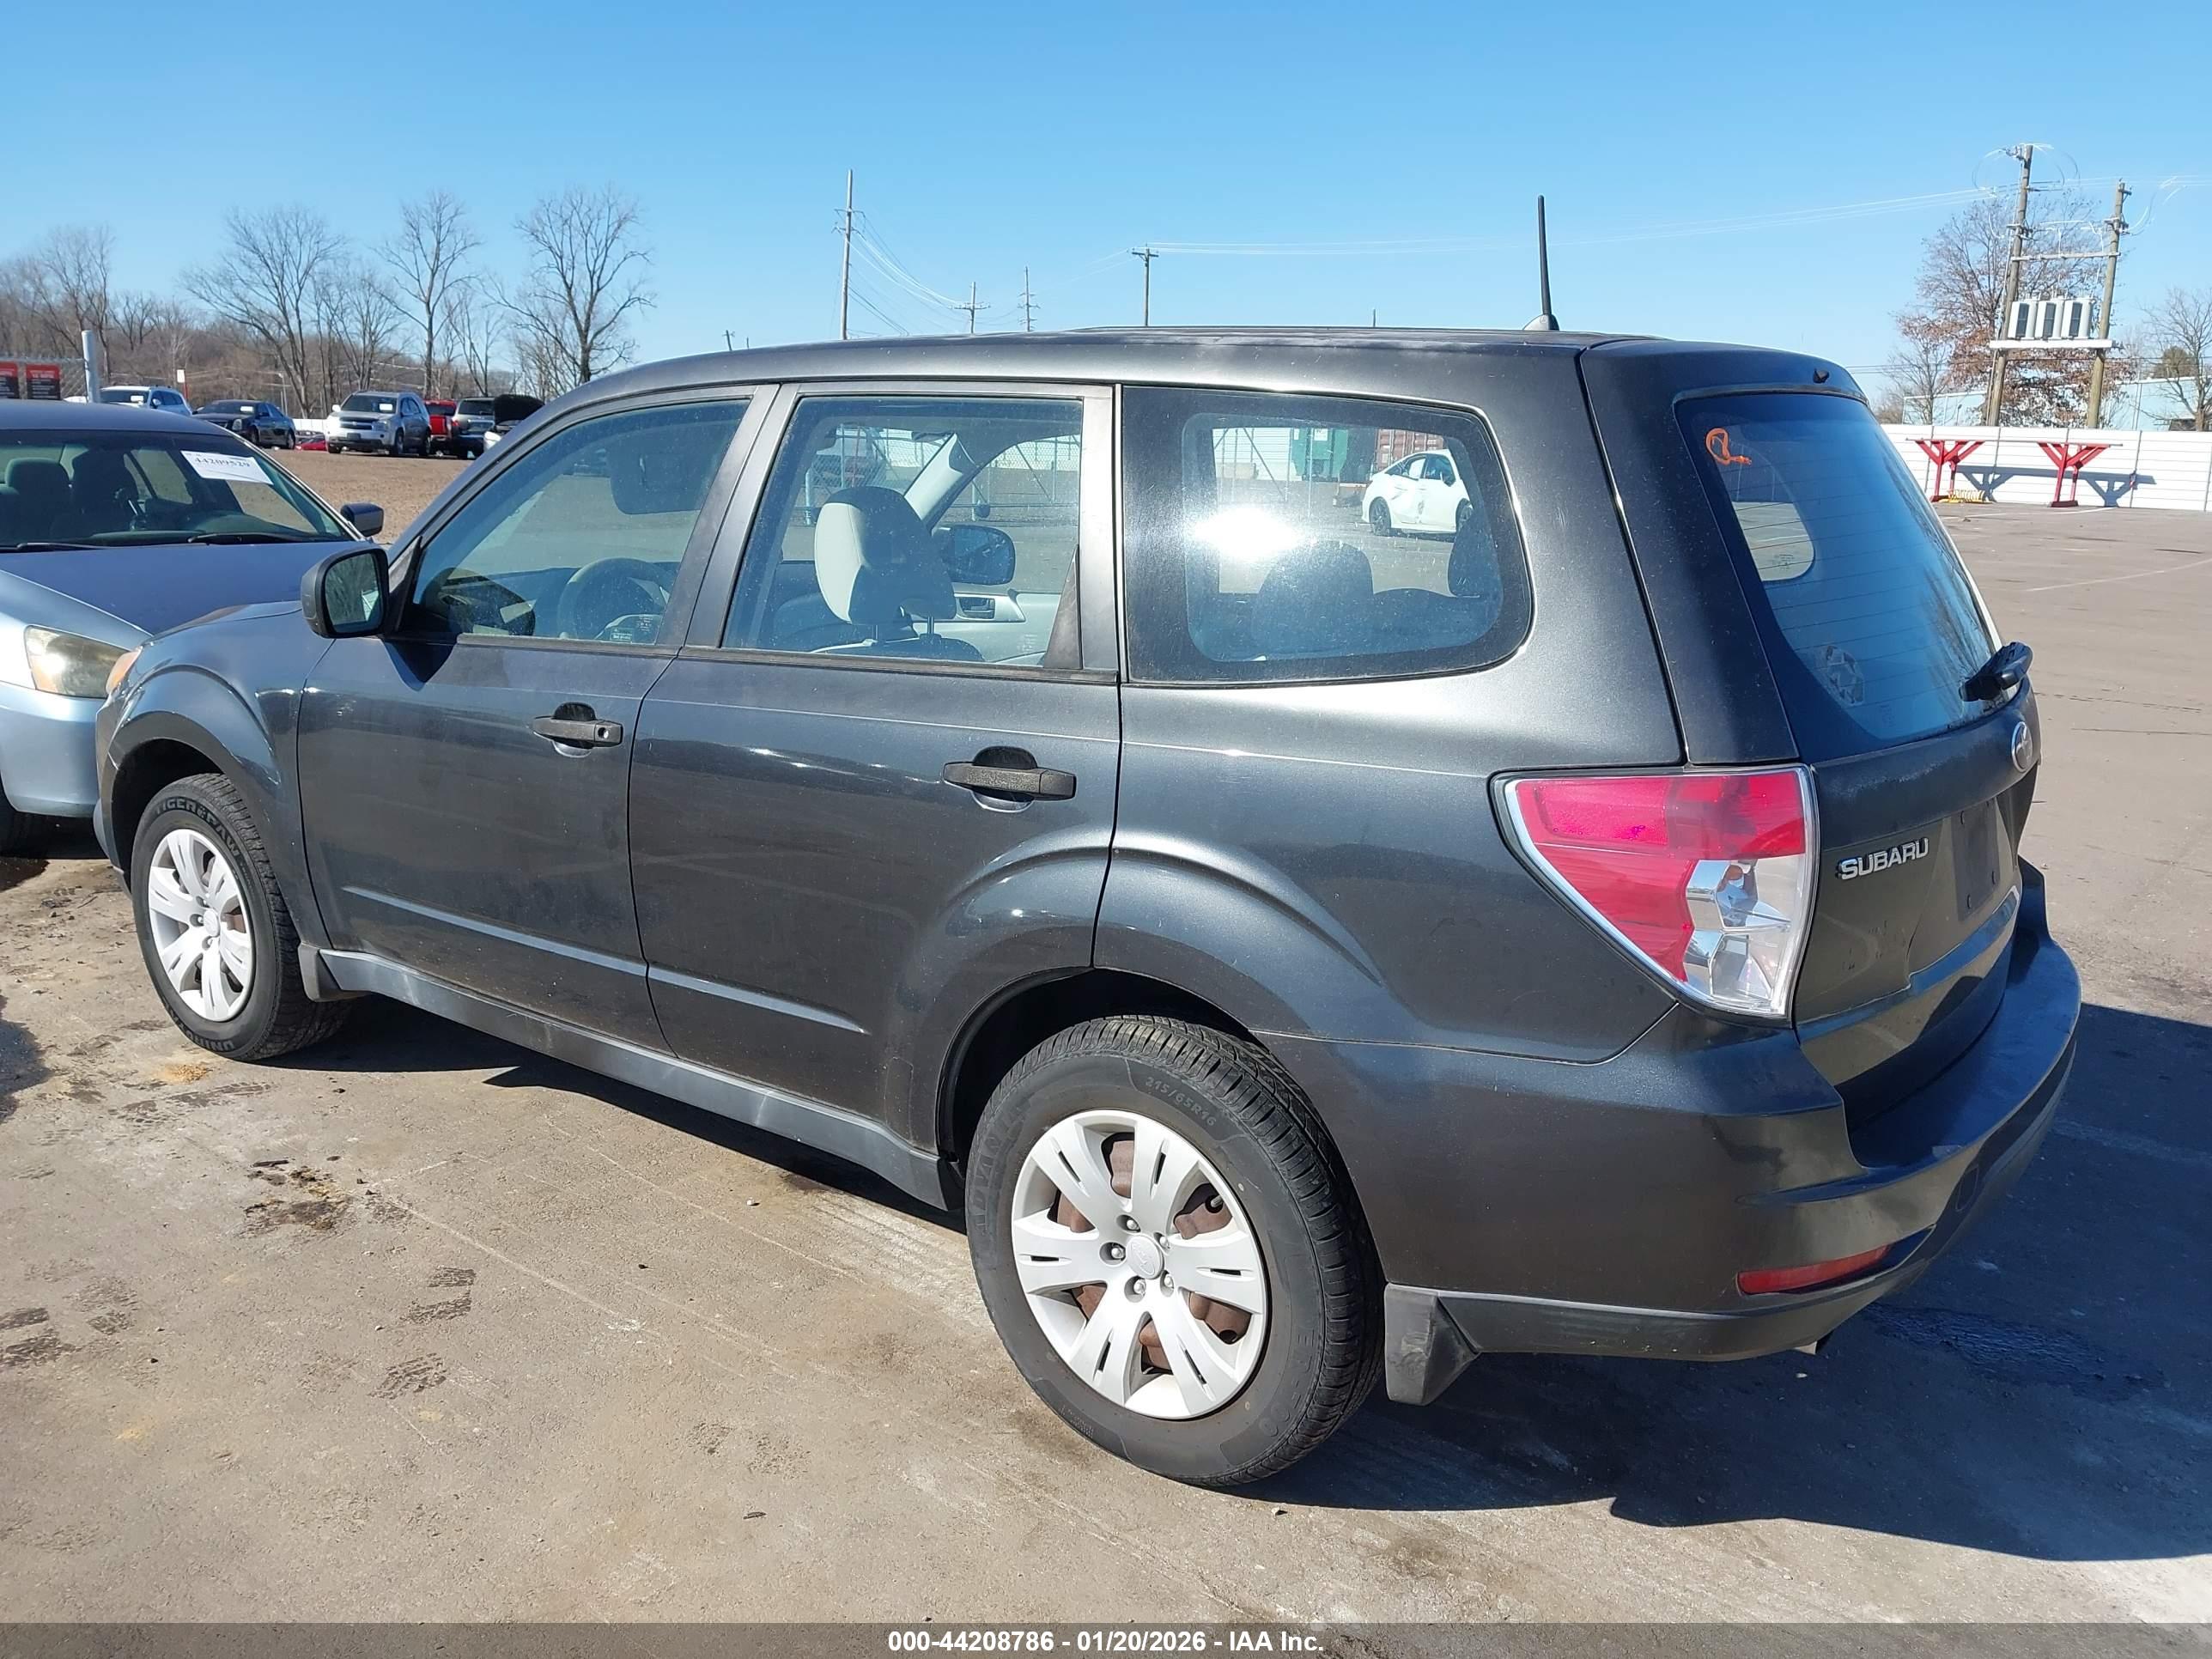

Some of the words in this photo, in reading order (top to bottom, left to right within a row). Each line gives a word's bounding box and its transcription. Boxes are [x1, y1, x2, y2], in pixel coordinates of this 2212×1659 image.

[155, 799, 196, 814] TIGER
[206, 812, 240, 856] PAW
[1838, 836, 1928, 880] SUBARU
[1145, 1076, 1217, 1127] 215/65R16
